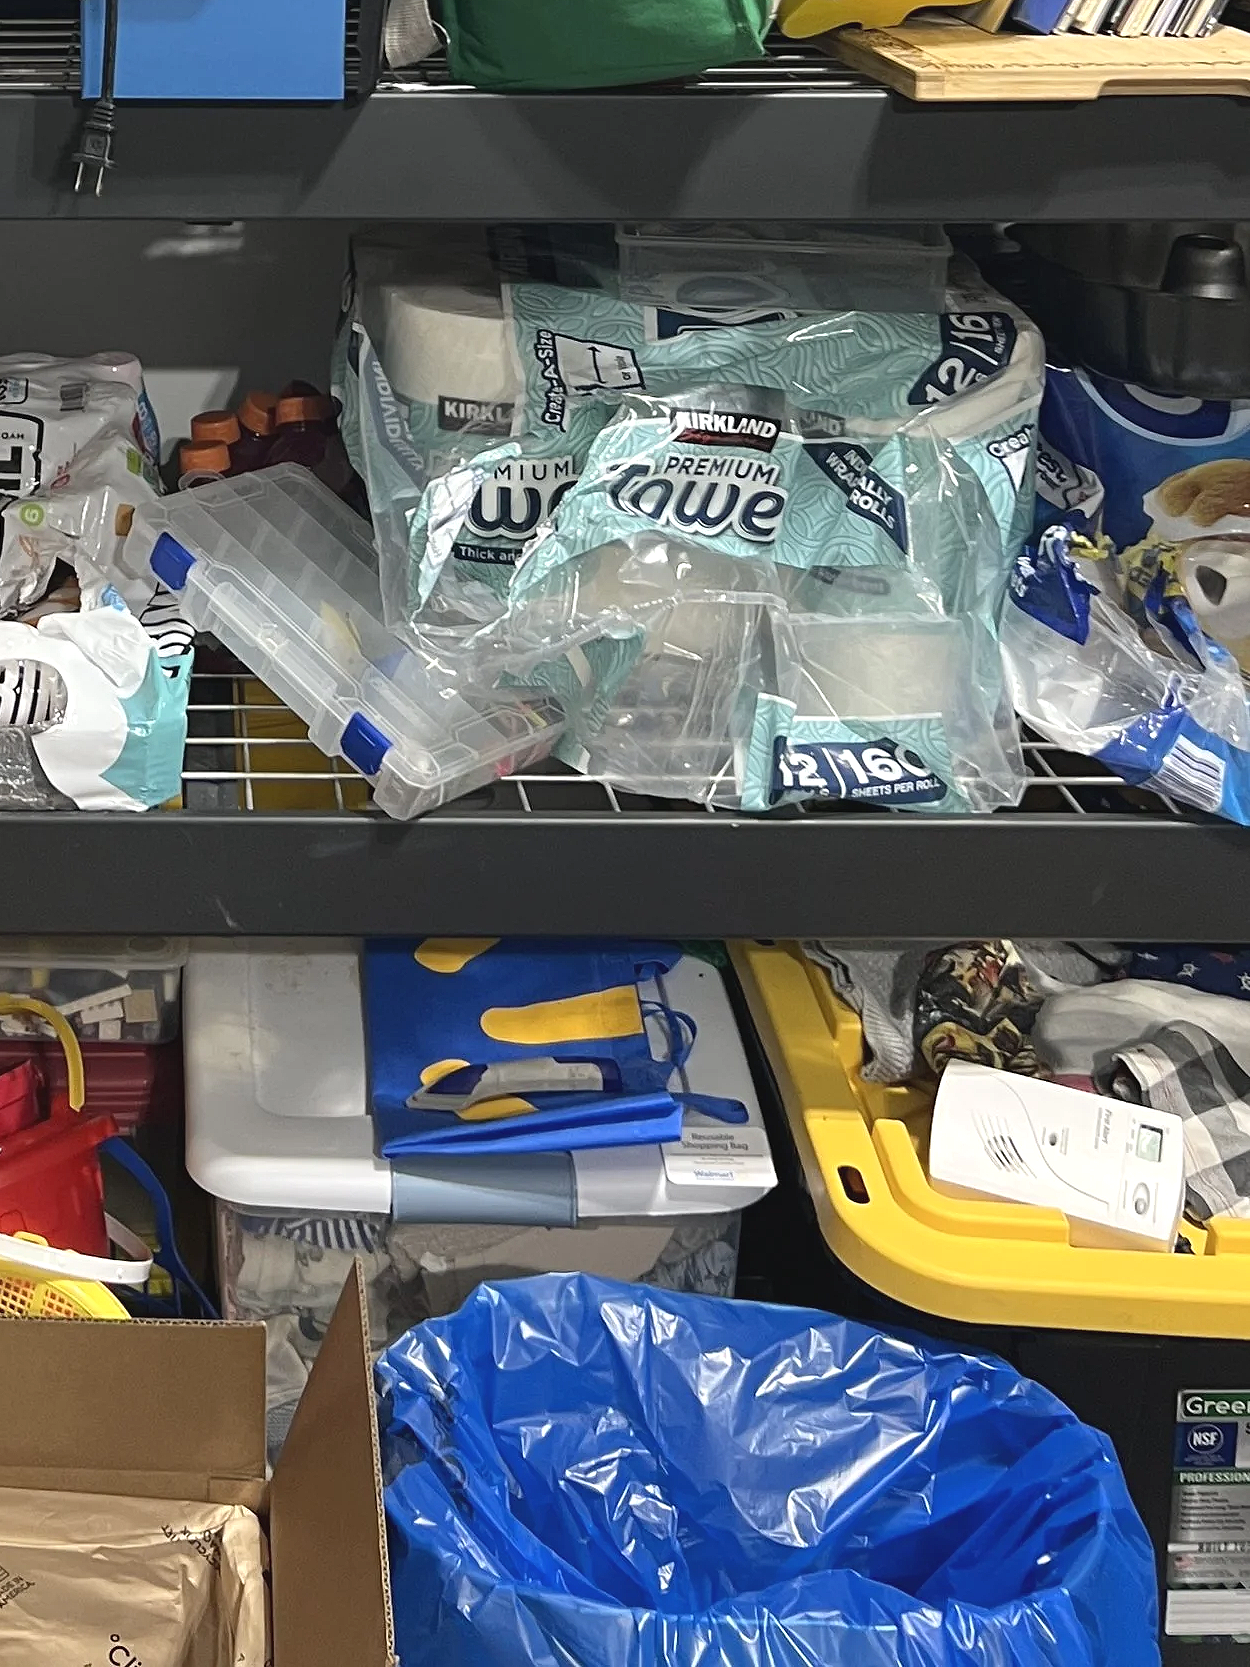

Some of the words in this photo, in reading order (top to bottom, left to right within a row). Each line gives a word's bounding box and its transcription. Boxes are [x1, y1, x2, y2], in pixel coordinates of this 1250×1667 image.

[444, 401, 512, 421] KIRKL
[676, 409, 777, 439] KIRKLAND
[664, 456, 781, 484] PREMIUM
[459, 546, 494, 560] Thick
[851, 786, 892, 797] SHEETS
[894, 782, 913, 793] PER
[915, 778, 939, 789] ROLL
[1192, 1433, 1218, 1447] NSF
